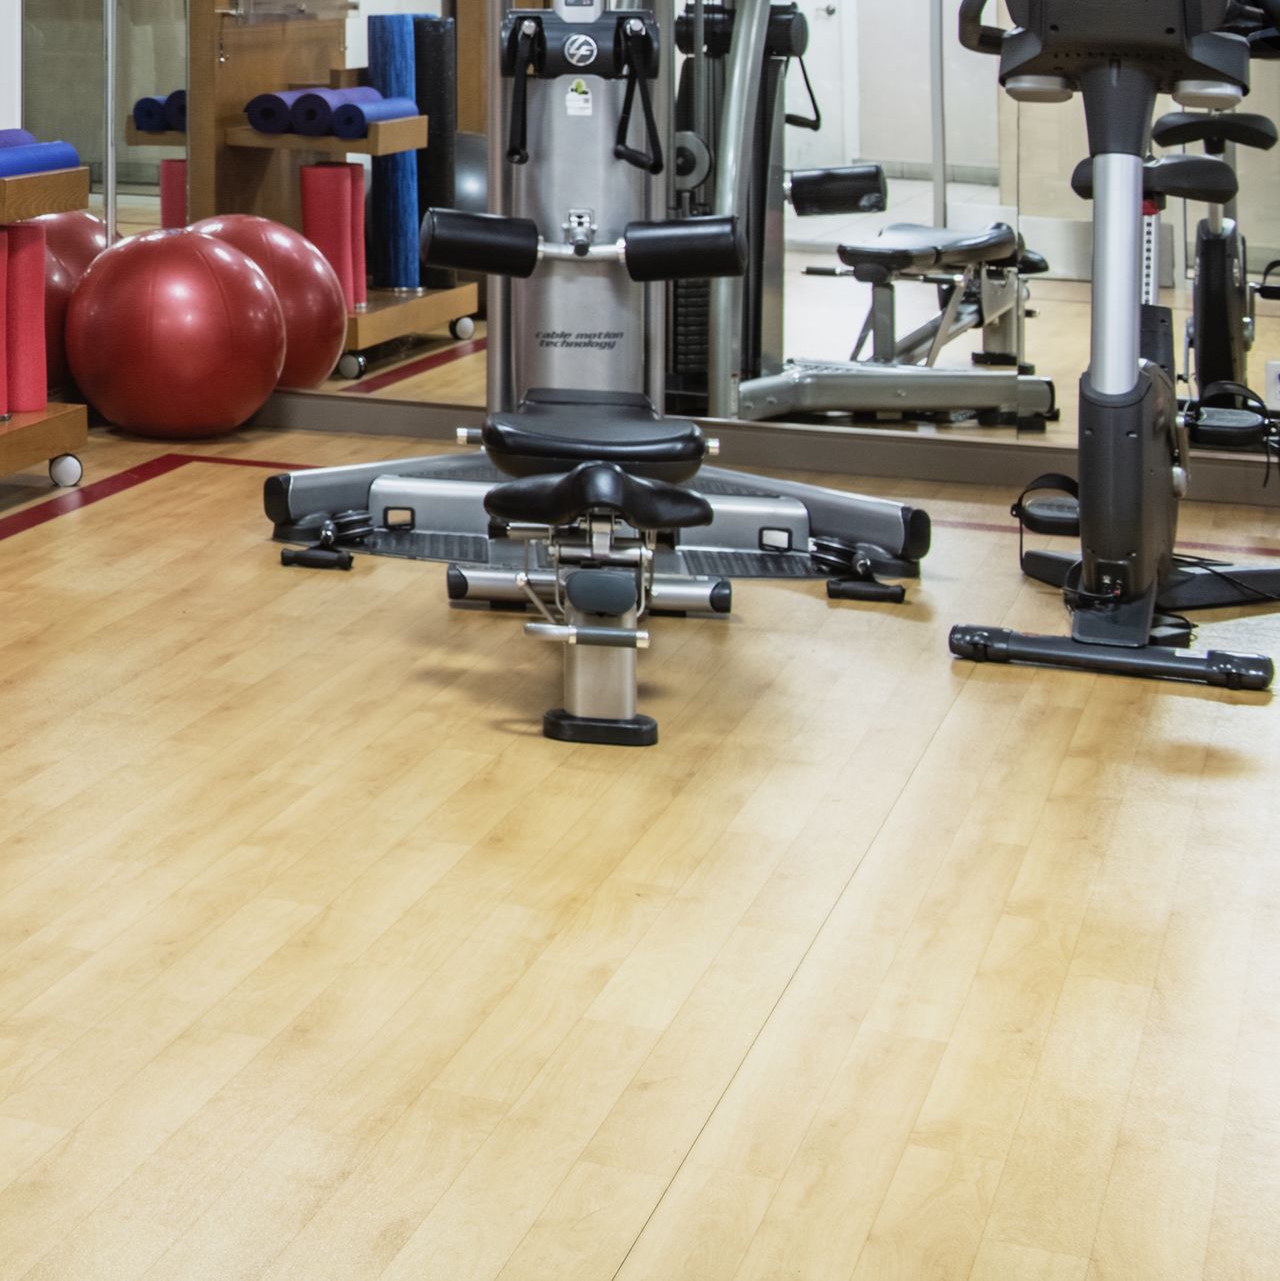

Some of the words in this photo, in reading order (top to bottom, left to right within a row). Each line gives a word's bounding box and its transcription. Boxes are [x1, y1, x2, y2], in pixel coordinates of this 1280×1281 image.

[535, 331, 572, 339] cable
[576, 331, 625, 339] motion
[539, 339, 617, 350] technology
